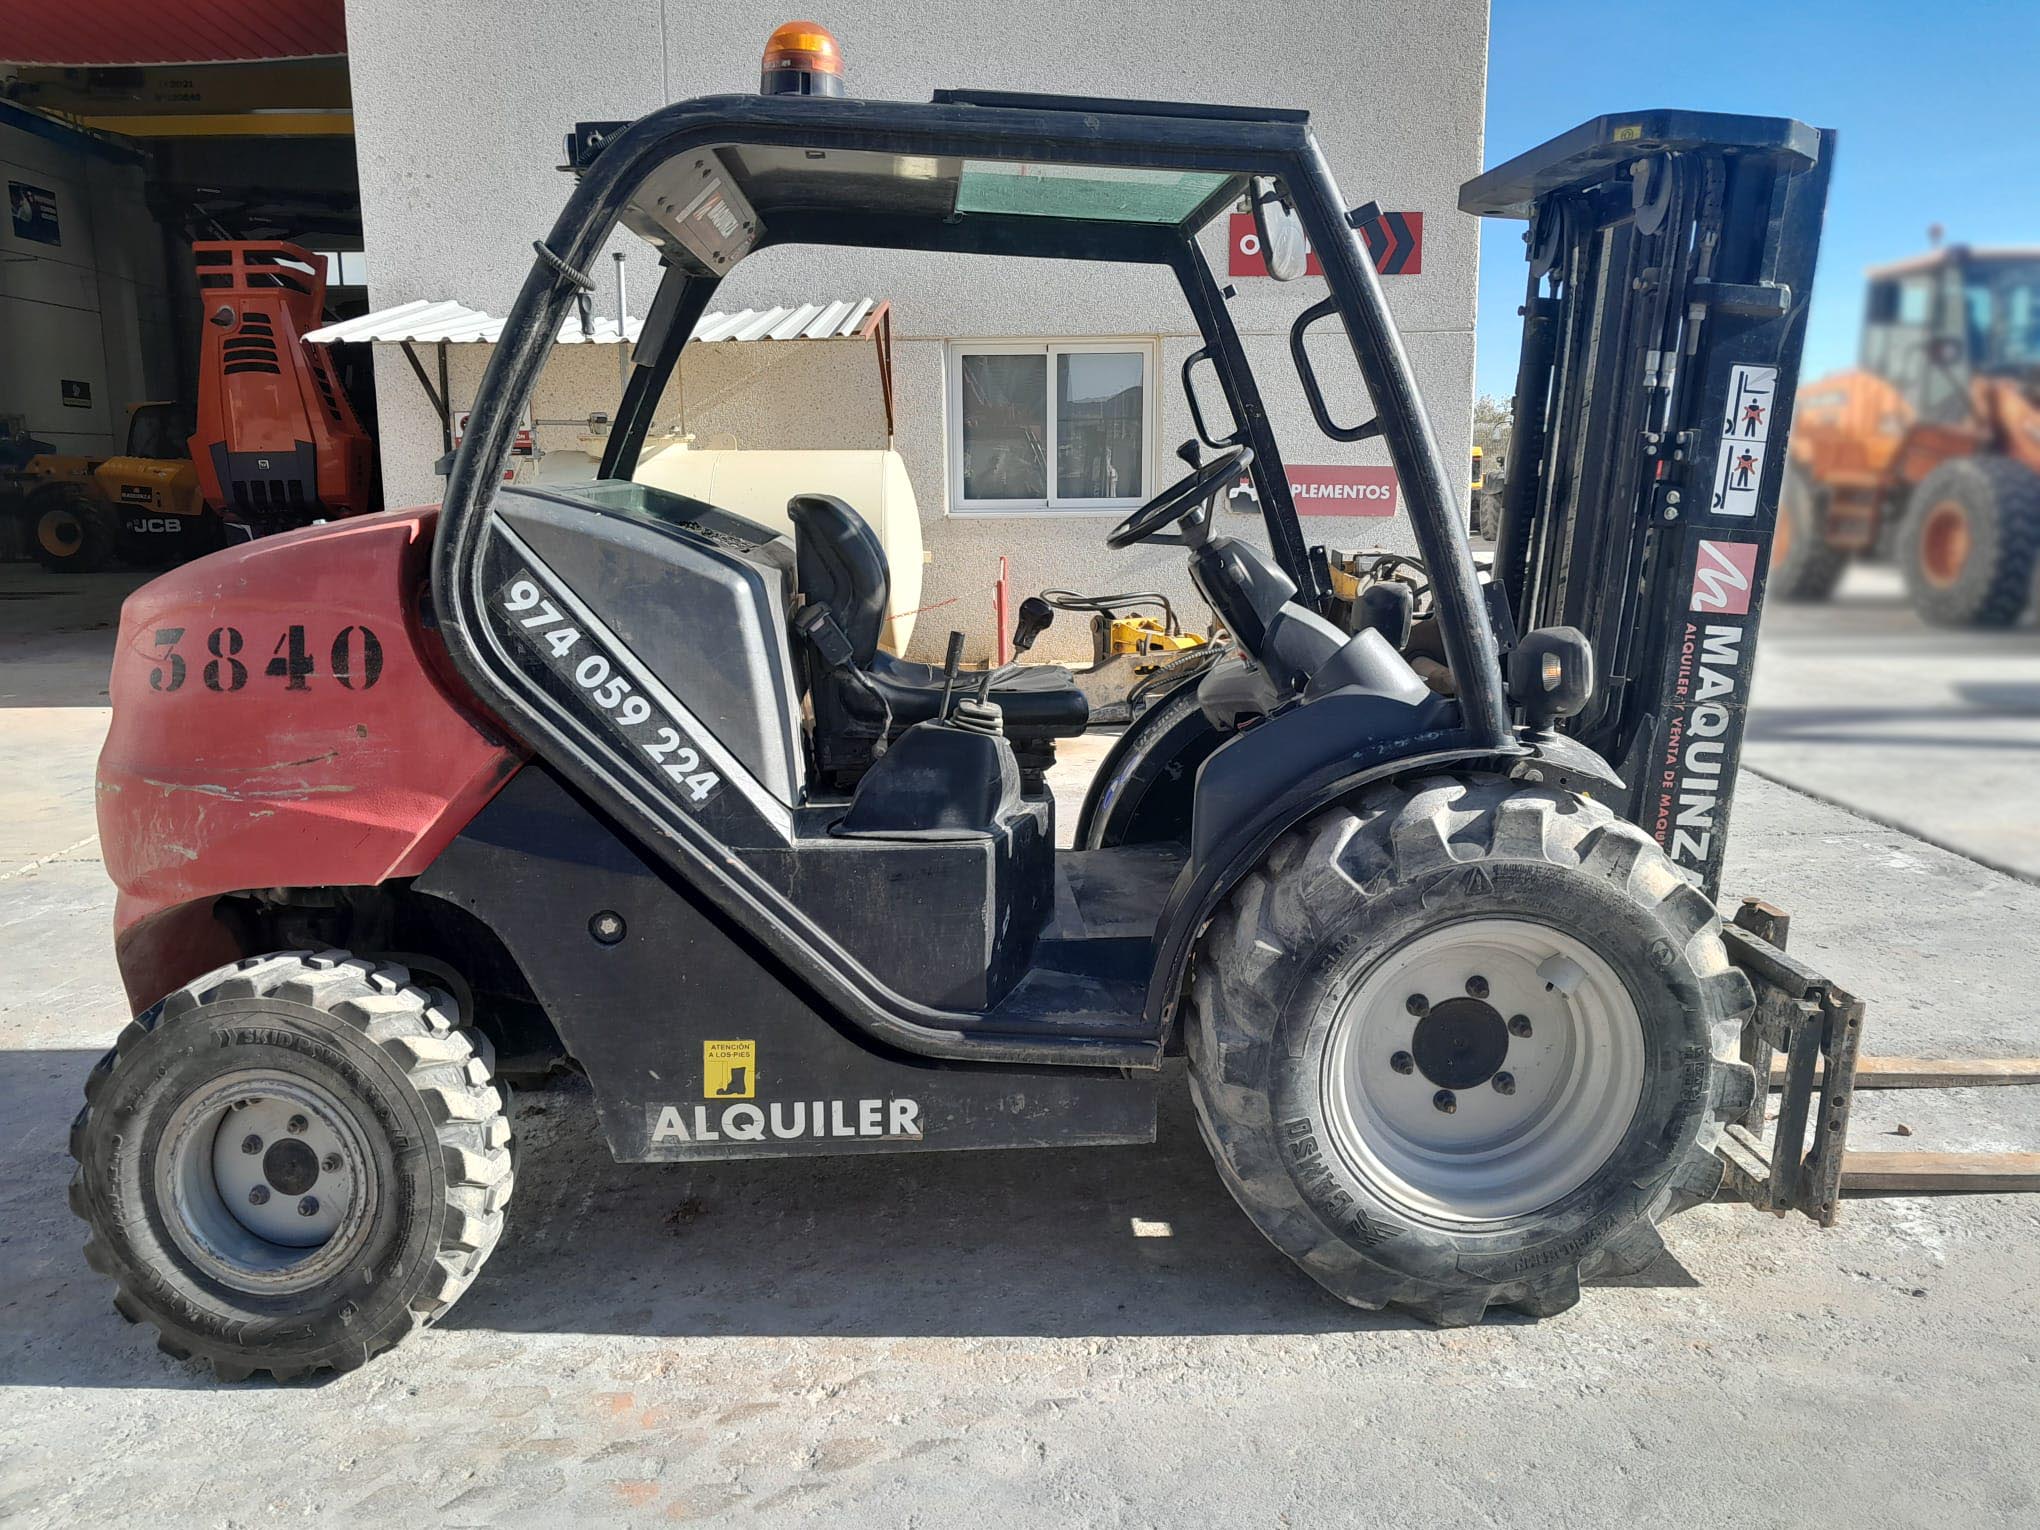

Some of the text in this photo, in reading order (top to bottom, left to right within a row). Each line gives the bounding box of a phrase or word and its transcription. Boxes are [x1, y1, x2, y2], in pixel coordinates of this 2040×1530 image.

[1291, 483, 1390, 500] PLEMENTOS
[134, 518, 182, 533] JCB
[149, 625, 383, 692] 3840
[1677, 622, 1698, 696] ALQUILER
[503, 580, 722, 802] 974 059 224
[1666, 716, 1684, 765] VENTA
[1662, 771, 1676, 788] DE
[651, 1099, 921, 1141] ALQUILER
[1284, 1117, 1355, 1219] CAMSO
